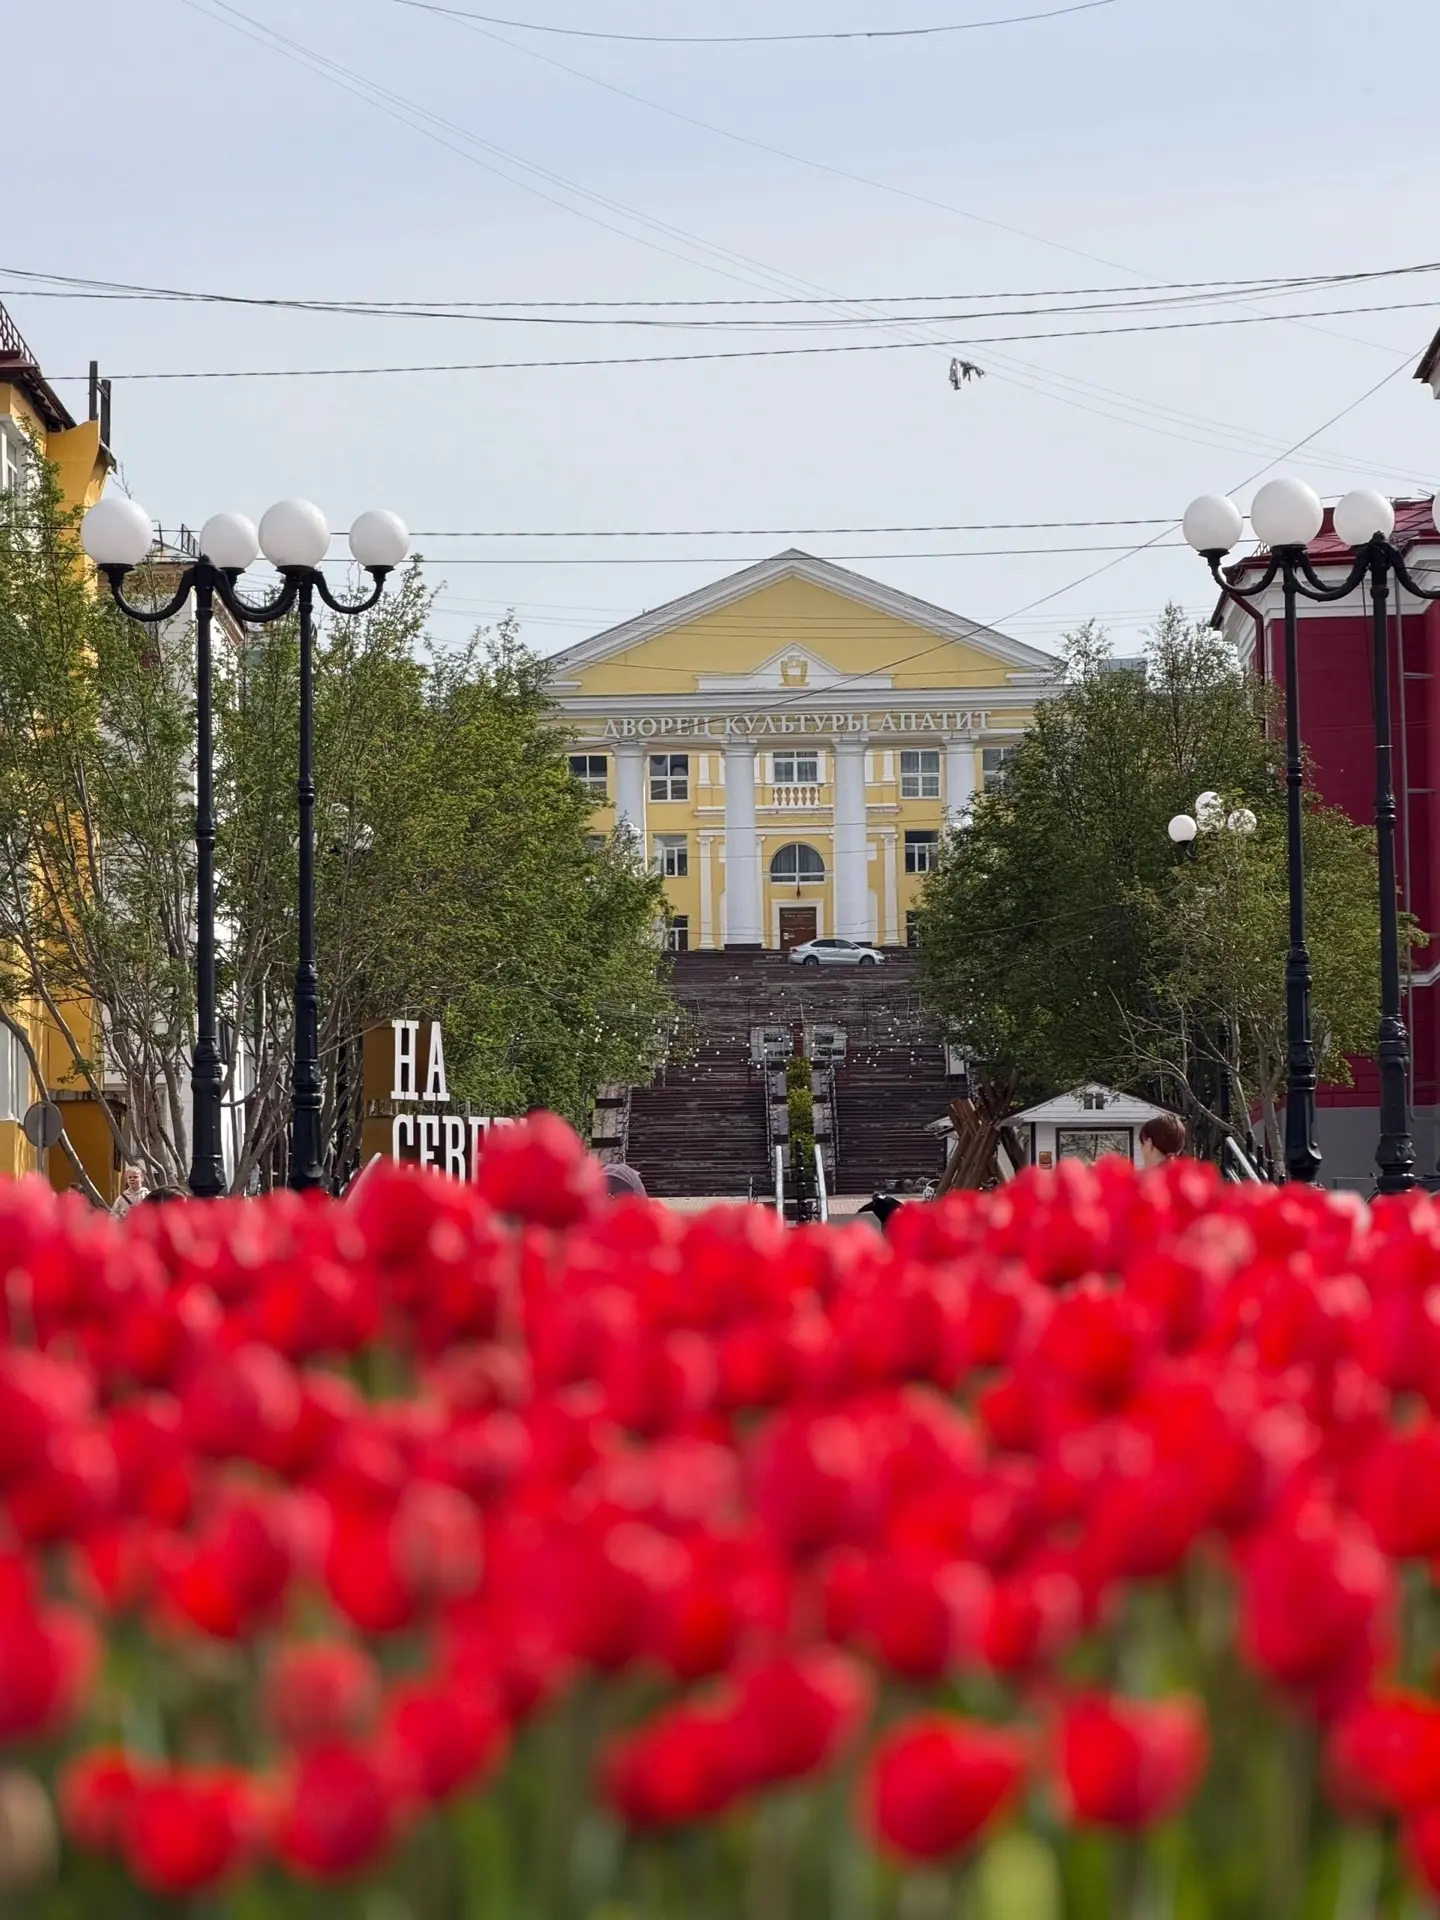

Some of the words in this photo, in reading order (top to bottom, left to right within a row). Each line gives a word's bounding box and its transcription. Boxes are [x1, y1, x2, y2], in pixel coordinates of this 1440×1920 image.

[604, 717, 712, 739] ДВОРЕЦ
[724, 713, 870, 734] КУЛЬТУРЫ
[879, 710, 992, 732] АПАТИТ
[391, 1019, 451, 1102] НА
